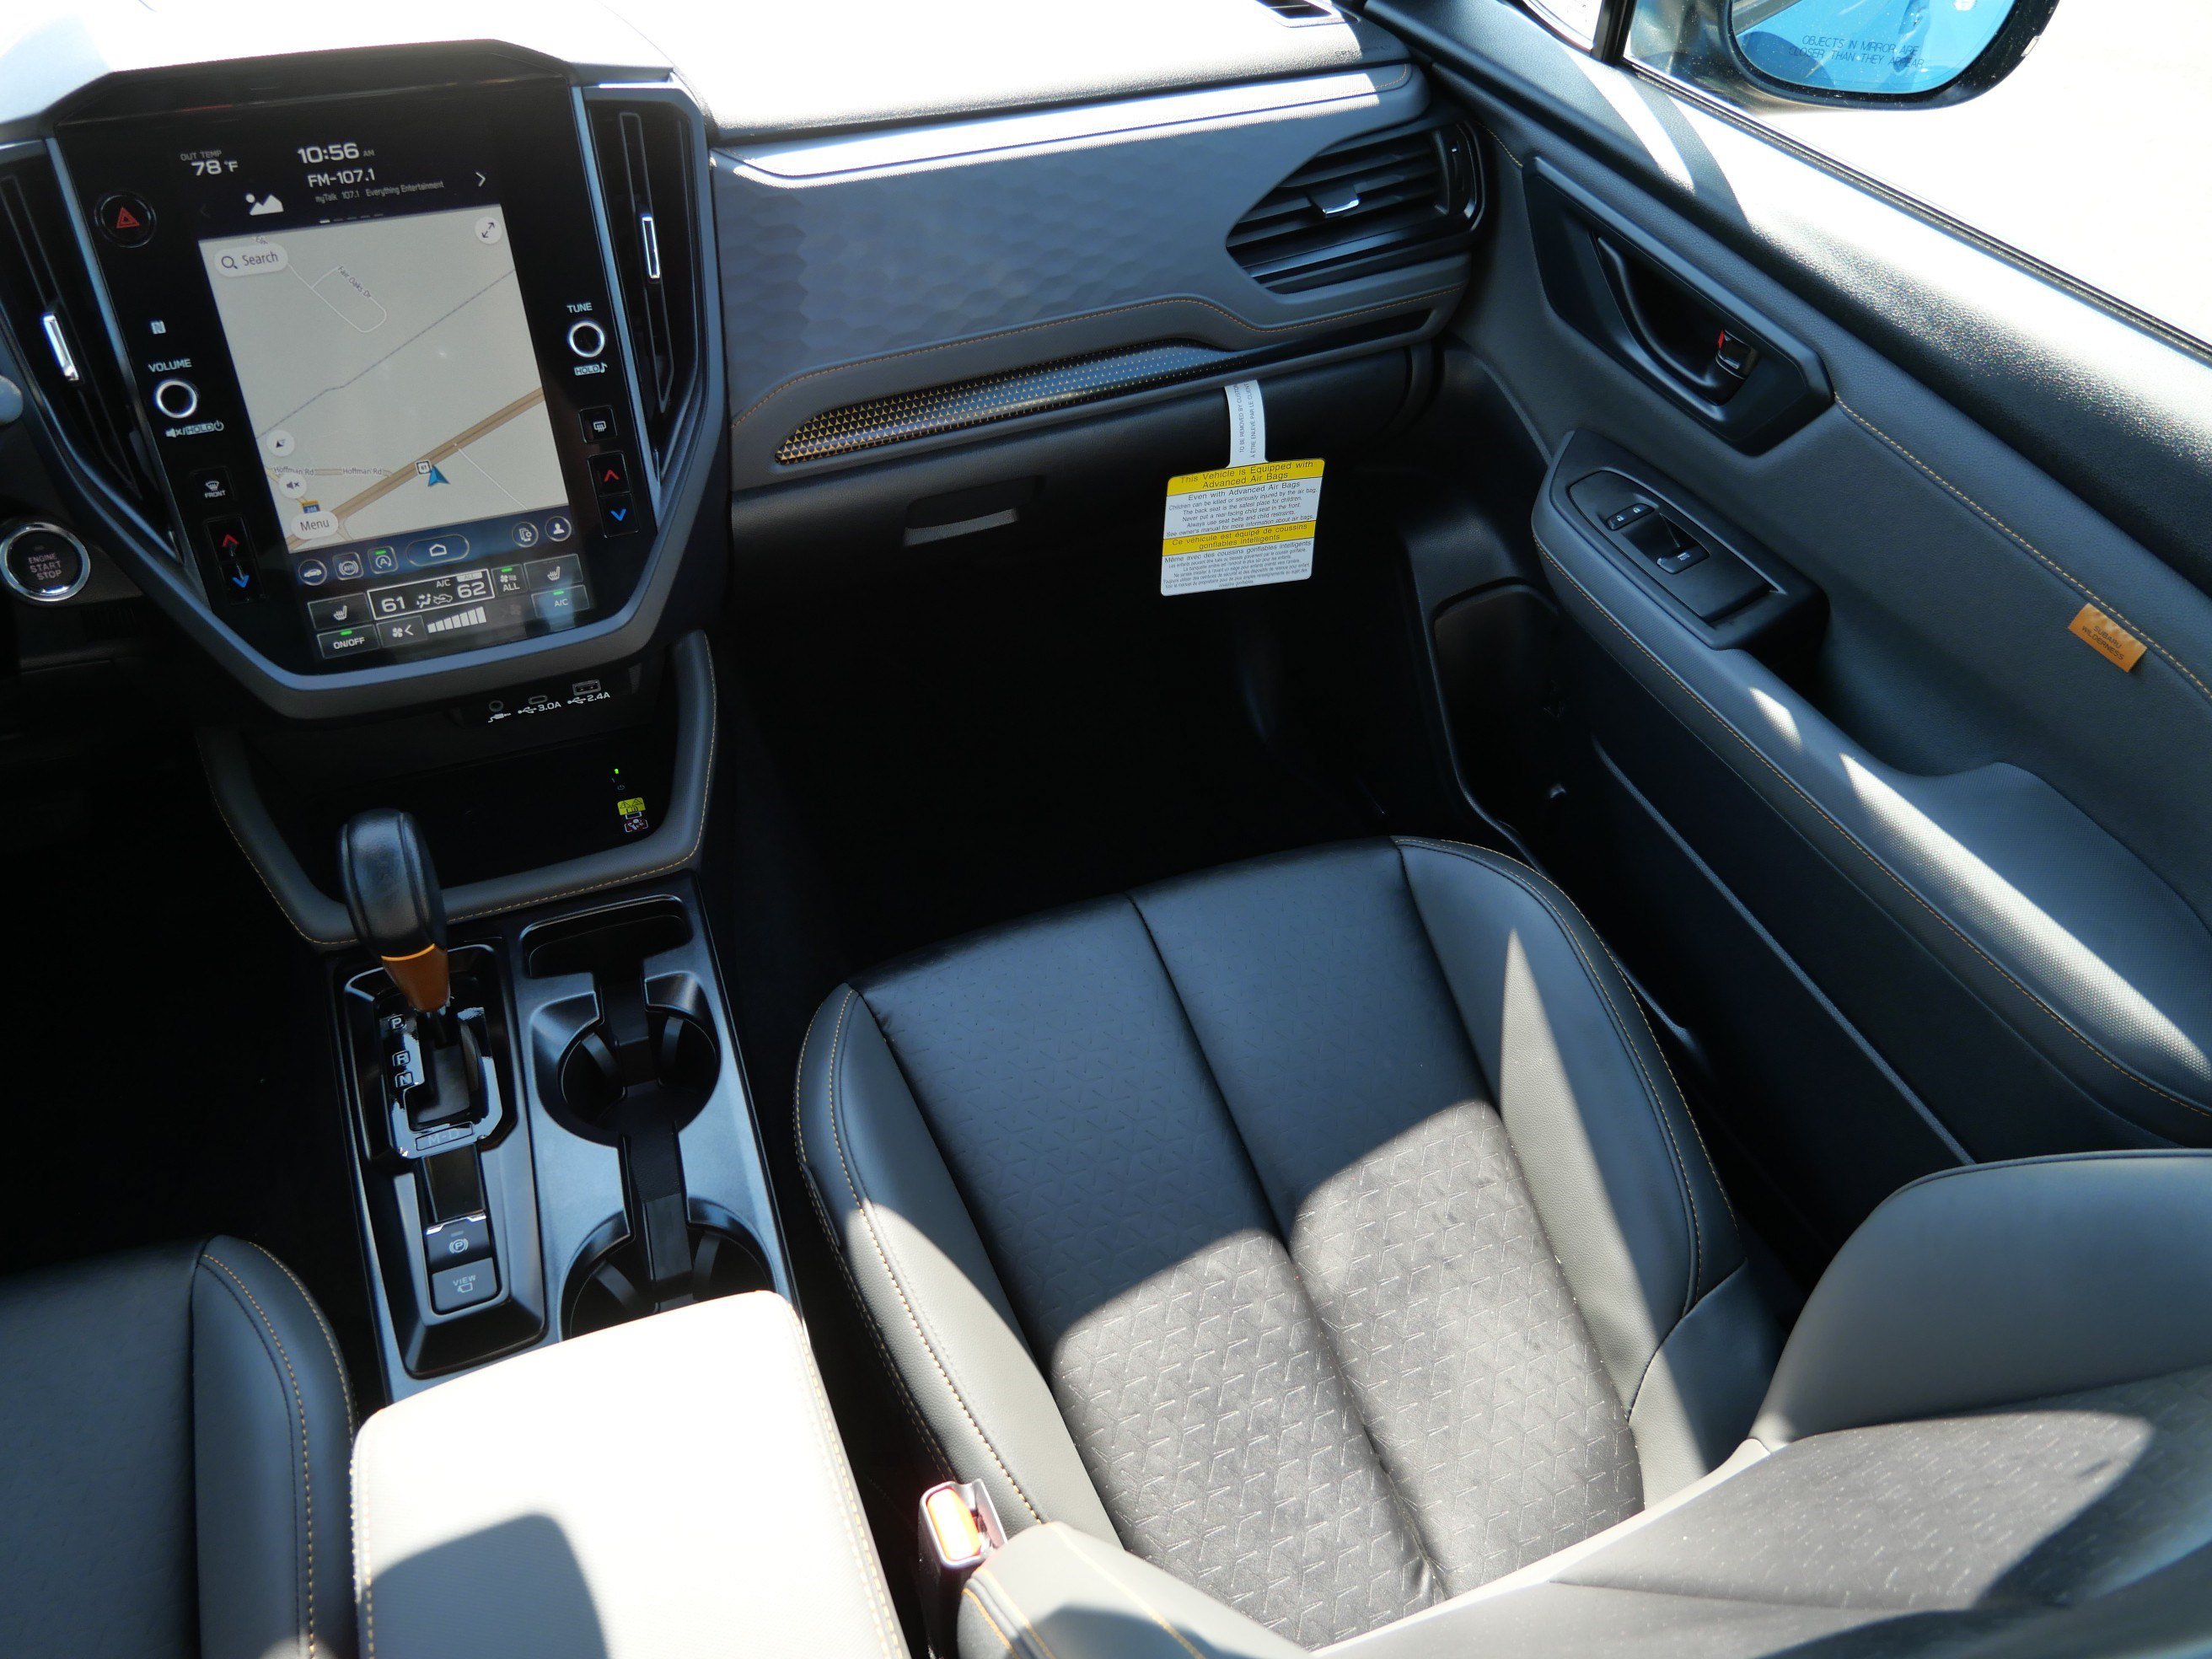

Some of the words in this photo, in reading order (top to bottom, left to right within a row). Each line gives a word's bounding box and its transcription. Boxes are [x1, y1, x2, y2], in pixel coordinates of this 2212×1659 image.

[1801, 35, 1844, 48] OBJECTS
[1848, 40, 1856, 49] IN
[1860, 41, 1896, 53] MIRROR
[1899, 46, 1919, 55] ARE
[1789, 47, 1824, 58] CLOSER
[1832, 50, 1855, 62] THAN
[1860, 53, 1884, 64] THEY
[1888, 57, 1924, 67] APPEAR
[180, 151, 197, 162] OUT
[201, 149, 223, 159] TEMP
[297, 142, 360, 164] 10:56
[362, 149, 375, 158] AM
[308, 168, 375, 188] FM-107.1
[341, 191, 360, 200] 107.1
[366, 186, 400, 197] Everything
[400, 180, 444, 193] Entertainment
[242, 250, 278, 266] Search
[566, 303, 593, 314] TUNE
[148, 358, 192, 373] VOLUME
[575, 365, 599, 375] HOLD
[274, 465, 303, 475] Hoffman
[1180, 475, 1198, 483] This
[1202, 470, 1234, 480] Vehicle
[1250, 462, 1291, 474] Equipped
[1295, 459, 1313, 469] with
[1202, 476, 1246, 488] Advanced
[1266, 471, 1288, 481] Bags
[204, 489, 226, 498] FRONT
[1228, 485, 1265, 495] Advanced
[1281, 481, 1300, 489] Bags
[300, 518, 330, 532] Menu
[1185, 534, 1217, 543] véhicule
[1234, 529, 1259, 538] équipé
[1275, 523, 1307, 532] coussins
[1199, 540, 1237, 550] gonflables
[1240, 534, 1280, 545] intelligents
[28, 552, 57, 564] ENGINE
[30, 561, 61, 573] START
[36, 569, 62, 580] STOP
[436, 578, 451, 588] A/C
[502, 583, 520, 593] ALL
[457, 582, 486, 599] 62
[381, 595, 406, 613] 61
[554, 598, 568, 607] A/C
[333, 636, 365, 650] ON/OFF
[2081, 625, 2124, 660] WILDERNESS
[2094, 625, 2122, 648] SUBARU
[587, 691, 611, 702] 2.4A
[538, 701, 561, 712] 3.0A
[391, 1017, 403, 1029] P
[396, 1054, 408, 1065] R
[399, 1073, 412, 1086] N
[453, 1274, 476, 1286] VIEW
